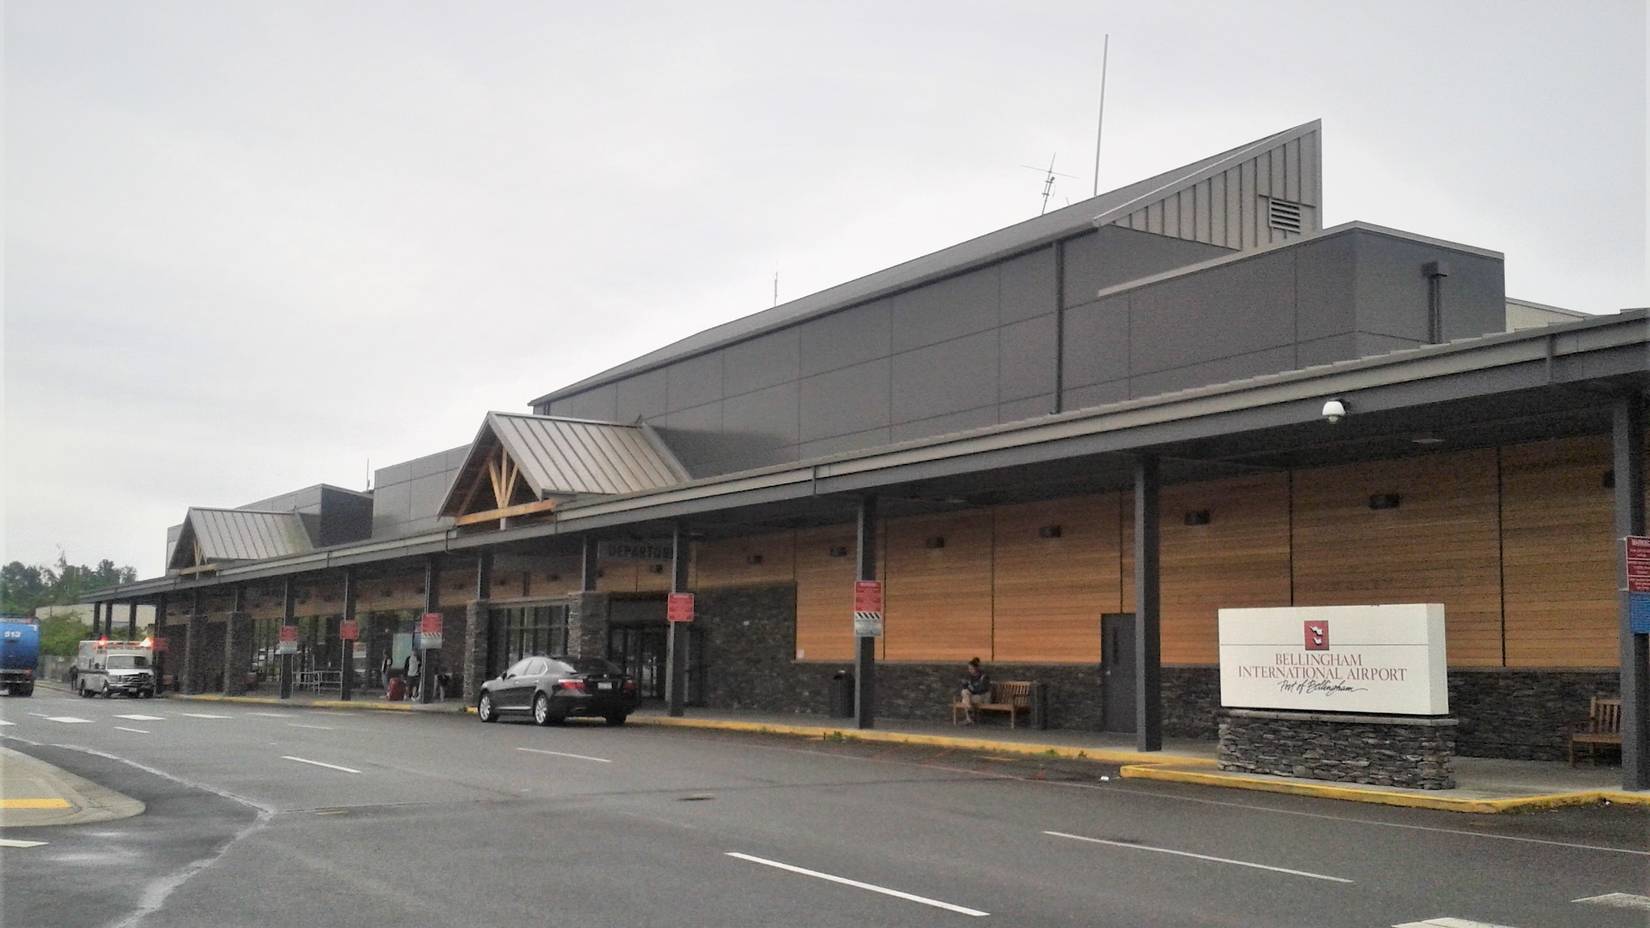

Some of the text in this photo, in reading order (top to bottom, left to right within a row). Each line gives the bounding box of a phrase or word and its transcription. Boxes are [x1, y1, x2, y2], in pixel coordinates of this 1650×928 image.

[1275, 653, 1362, 666] BELLINGHAM
[1238, 666, 1407, 681] INTERNATIONAL AIRPORT
[1279, 679, 1368, 696] Port of Bellingham
